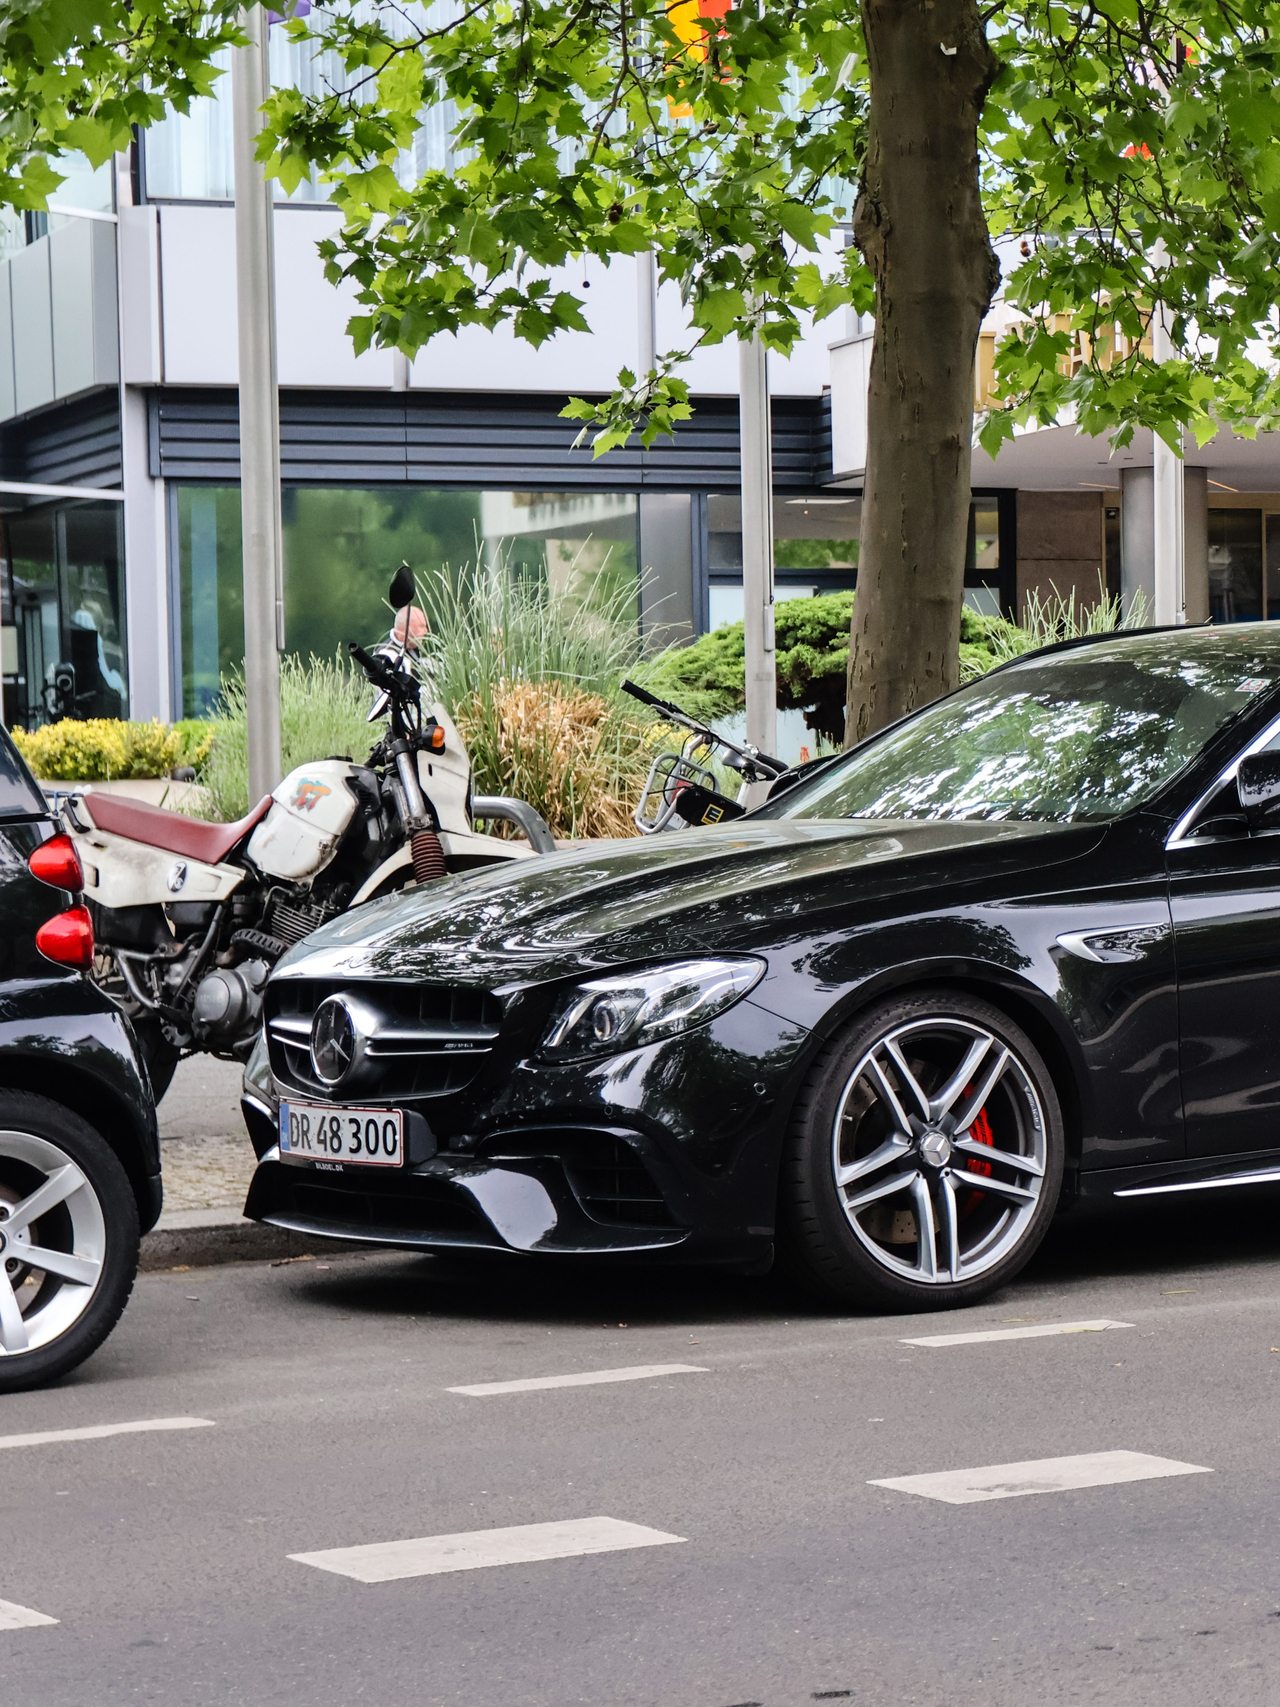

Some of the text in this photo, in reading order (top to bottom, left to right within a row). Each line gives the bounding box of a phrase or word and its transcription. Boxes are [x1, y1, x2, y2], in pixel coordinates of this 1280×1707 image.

[289, 1111, 398, 1156] DR 48 300
